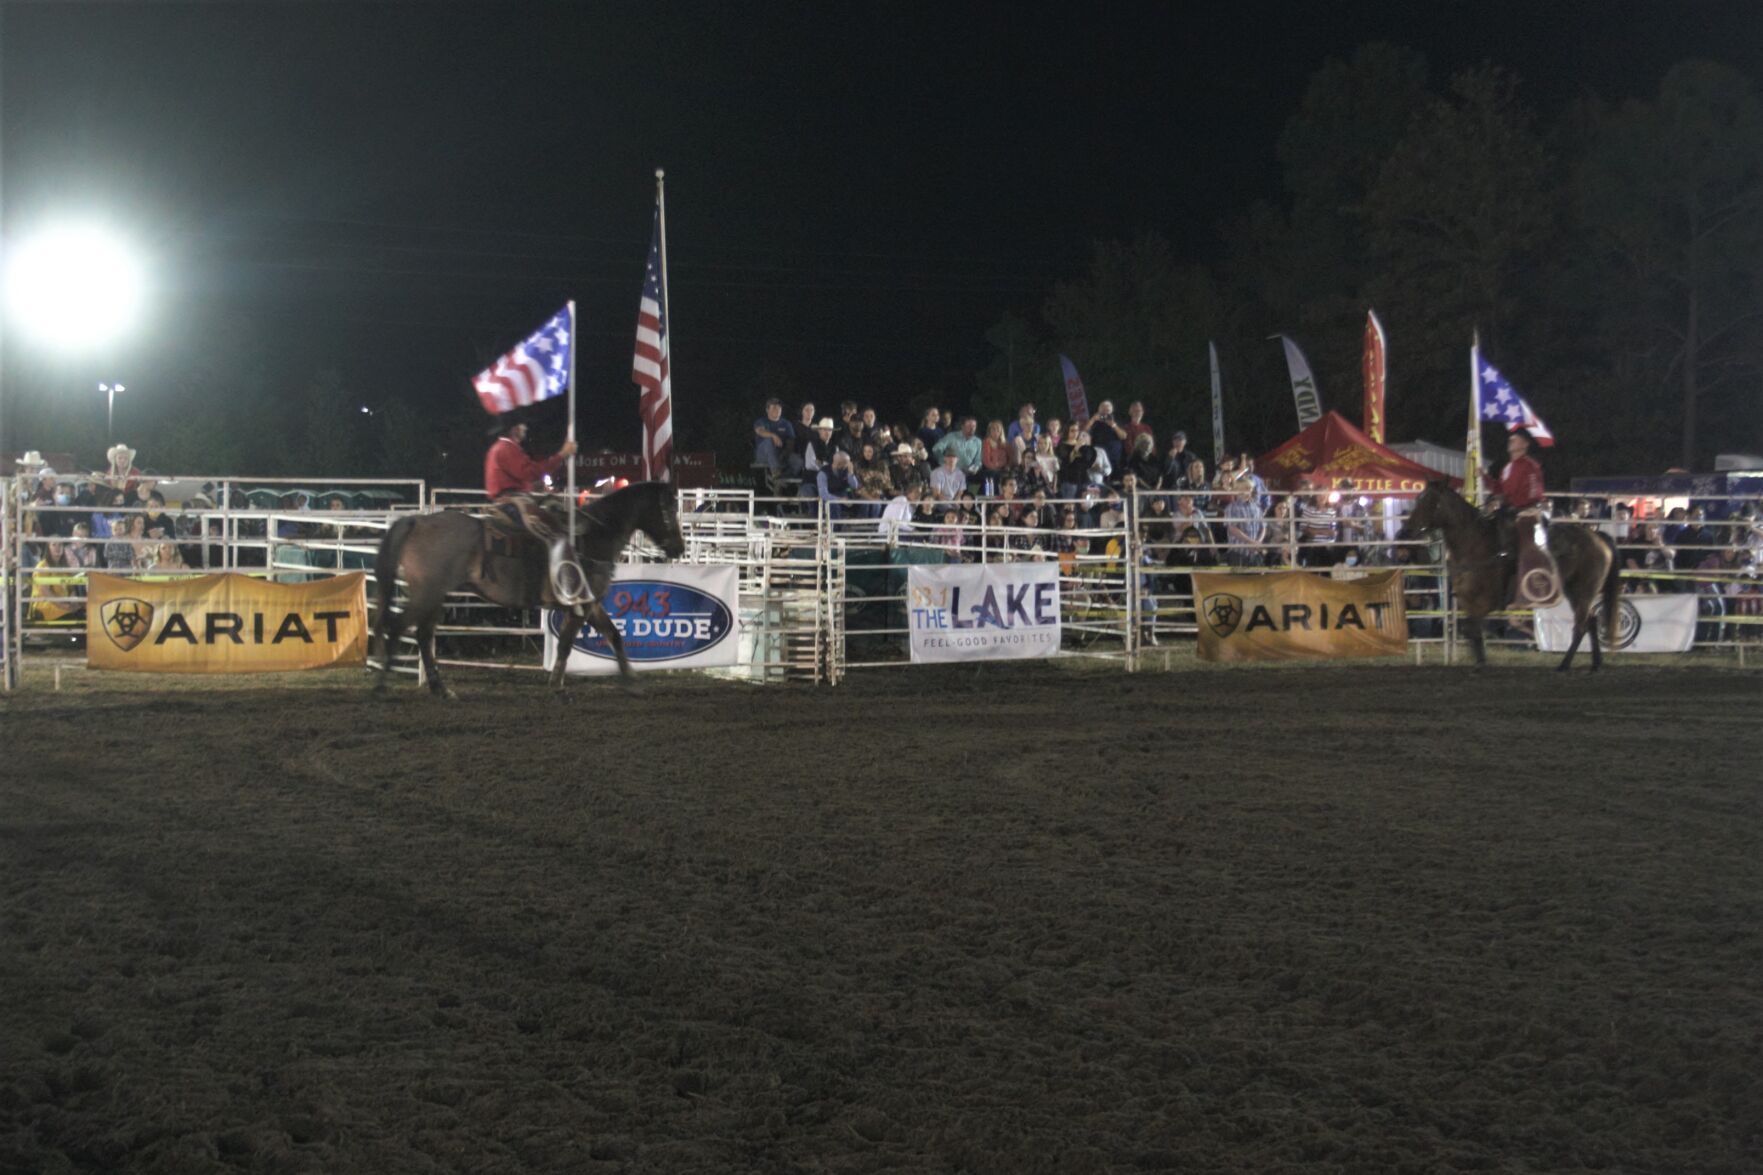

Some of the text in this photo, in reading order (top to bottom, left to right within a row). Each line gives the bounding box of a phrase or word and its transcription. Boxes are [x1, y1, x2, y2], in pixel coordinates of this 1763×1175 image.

[610, 454, 626, 466] ON
[1331, 477, 1392, 492] KTTLE
[613, 591, 672, 618] 94.3
[912, 582, 1056, 630] THE LAKE
[1245, 601, 1393, 632] ARIAT
[154, 610, 351, 645] ARIAT
[633, 618, 711, 640] DUDE
